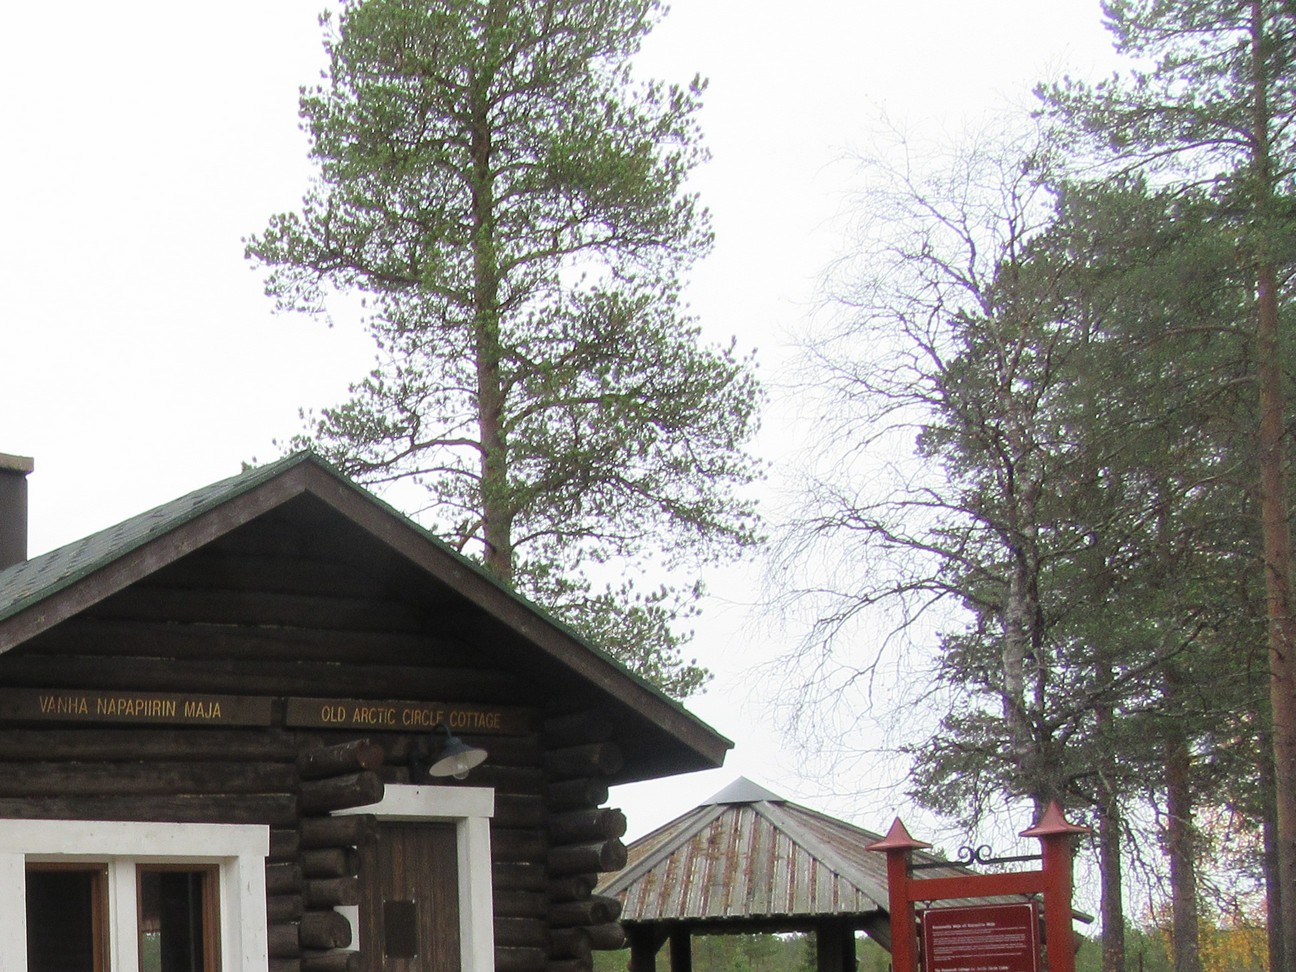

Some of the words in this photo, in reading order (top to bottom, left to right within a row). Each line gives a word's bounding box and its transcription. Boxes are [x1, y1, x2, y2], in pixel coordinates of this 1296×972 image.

[39, 696, 88, 714] VANHA
[97, 698, 176, 717] NAPAPIIRIN
[184, 701, 221, 718] MAJA
[321, 706, 346, 722] OLD
[353, 707, 396, 725] ARCTIC
[449, 711, 501, 729] COTTAGE
